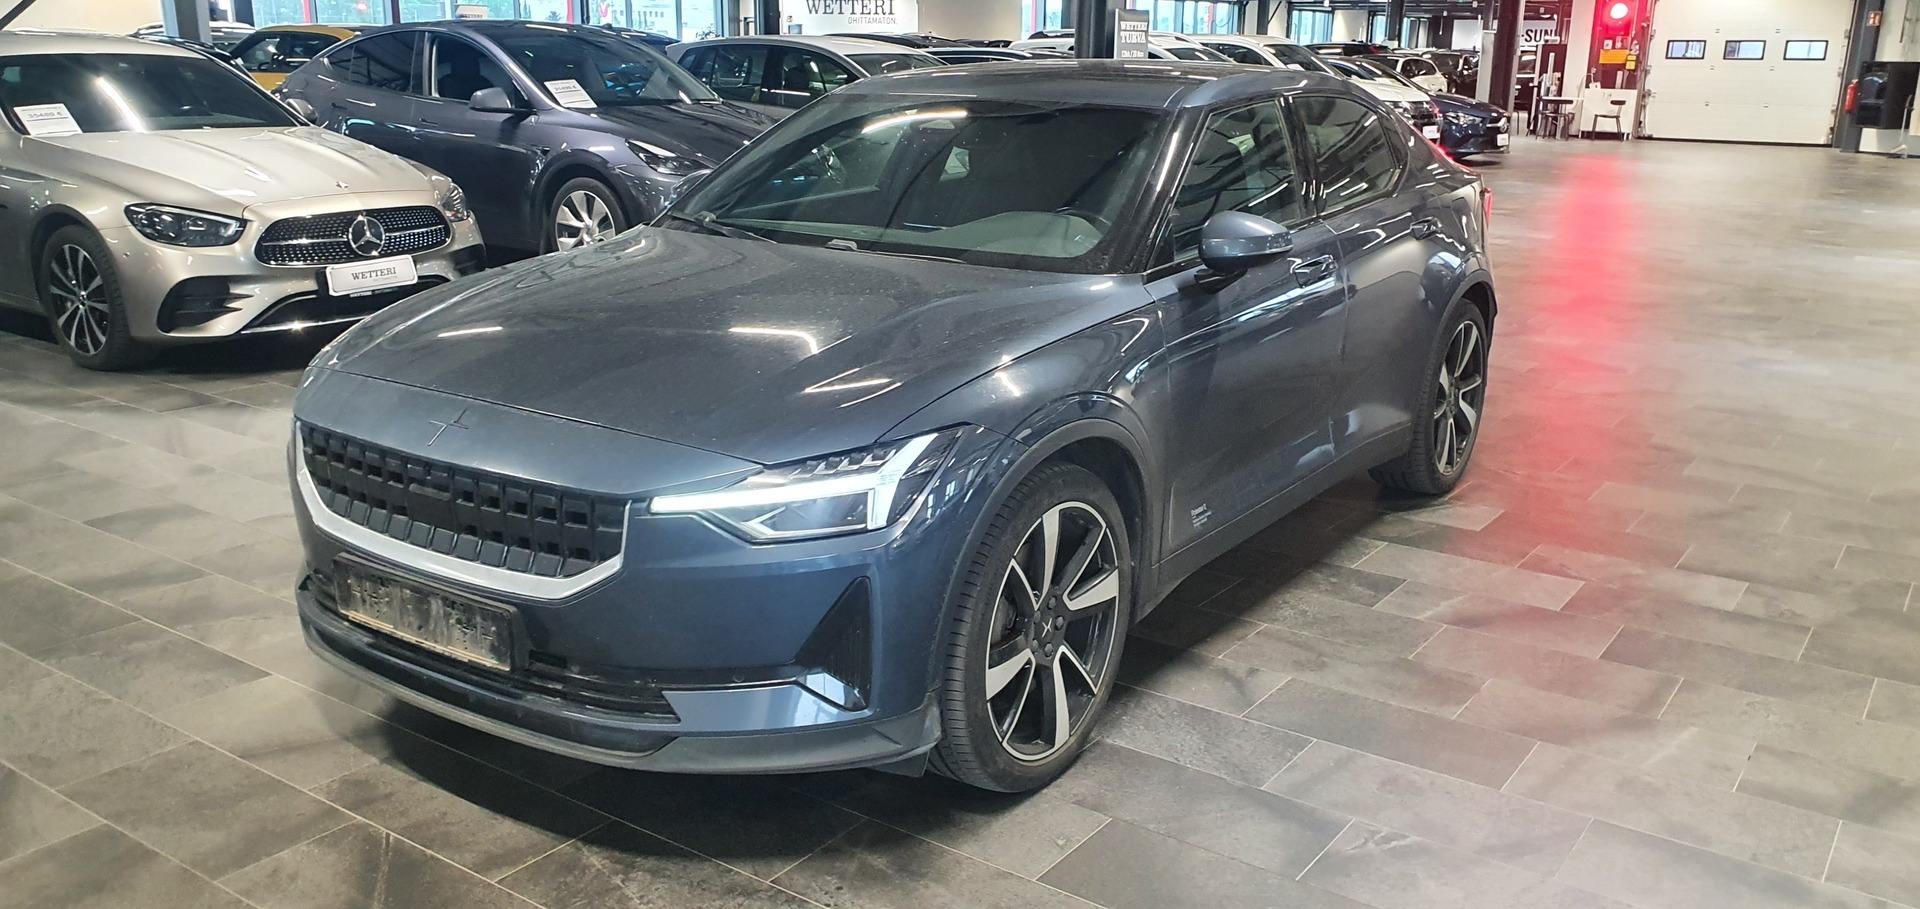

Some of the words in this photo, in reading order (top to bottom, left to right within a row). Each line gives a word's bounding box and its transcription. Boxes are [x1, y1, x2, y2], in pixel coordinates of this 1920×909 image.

[806, 0, 895, 15] WETTERI
[847, 16, 898, 25] OHITTAMATON.
[351, 266, 397, 281] WETTERI
